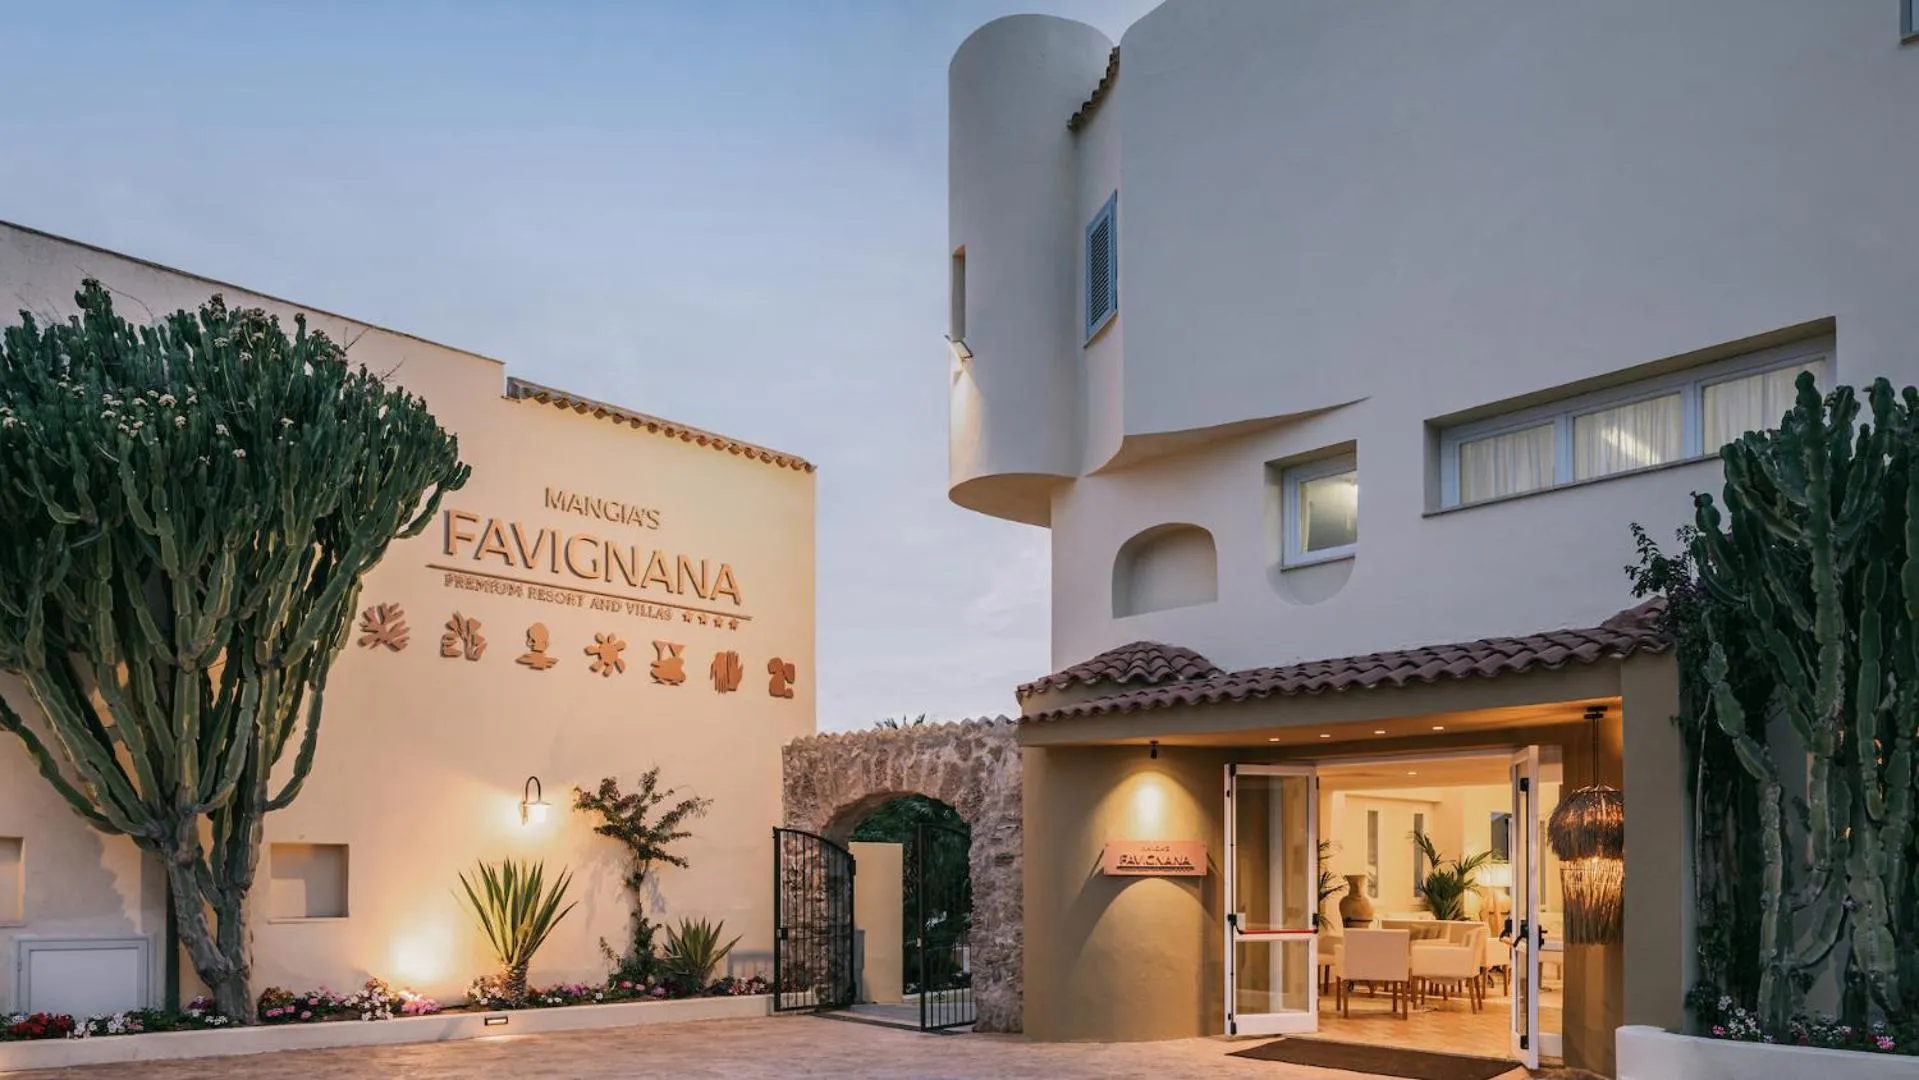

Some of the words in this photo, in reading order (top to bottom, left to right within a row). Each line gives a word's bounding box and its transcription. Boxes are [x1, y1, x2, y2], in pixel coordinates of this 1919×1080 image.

[545, 487, 661, 530] MANGIA'S
[443, 508, 743, 606] FAVIGNANA
[444, 574, 523, 599] PREMIUM
[527, 585, 584, 608] RESORT
[589, 597, 623, 613] AND
[626, 603, 673, 622] VILLAS
